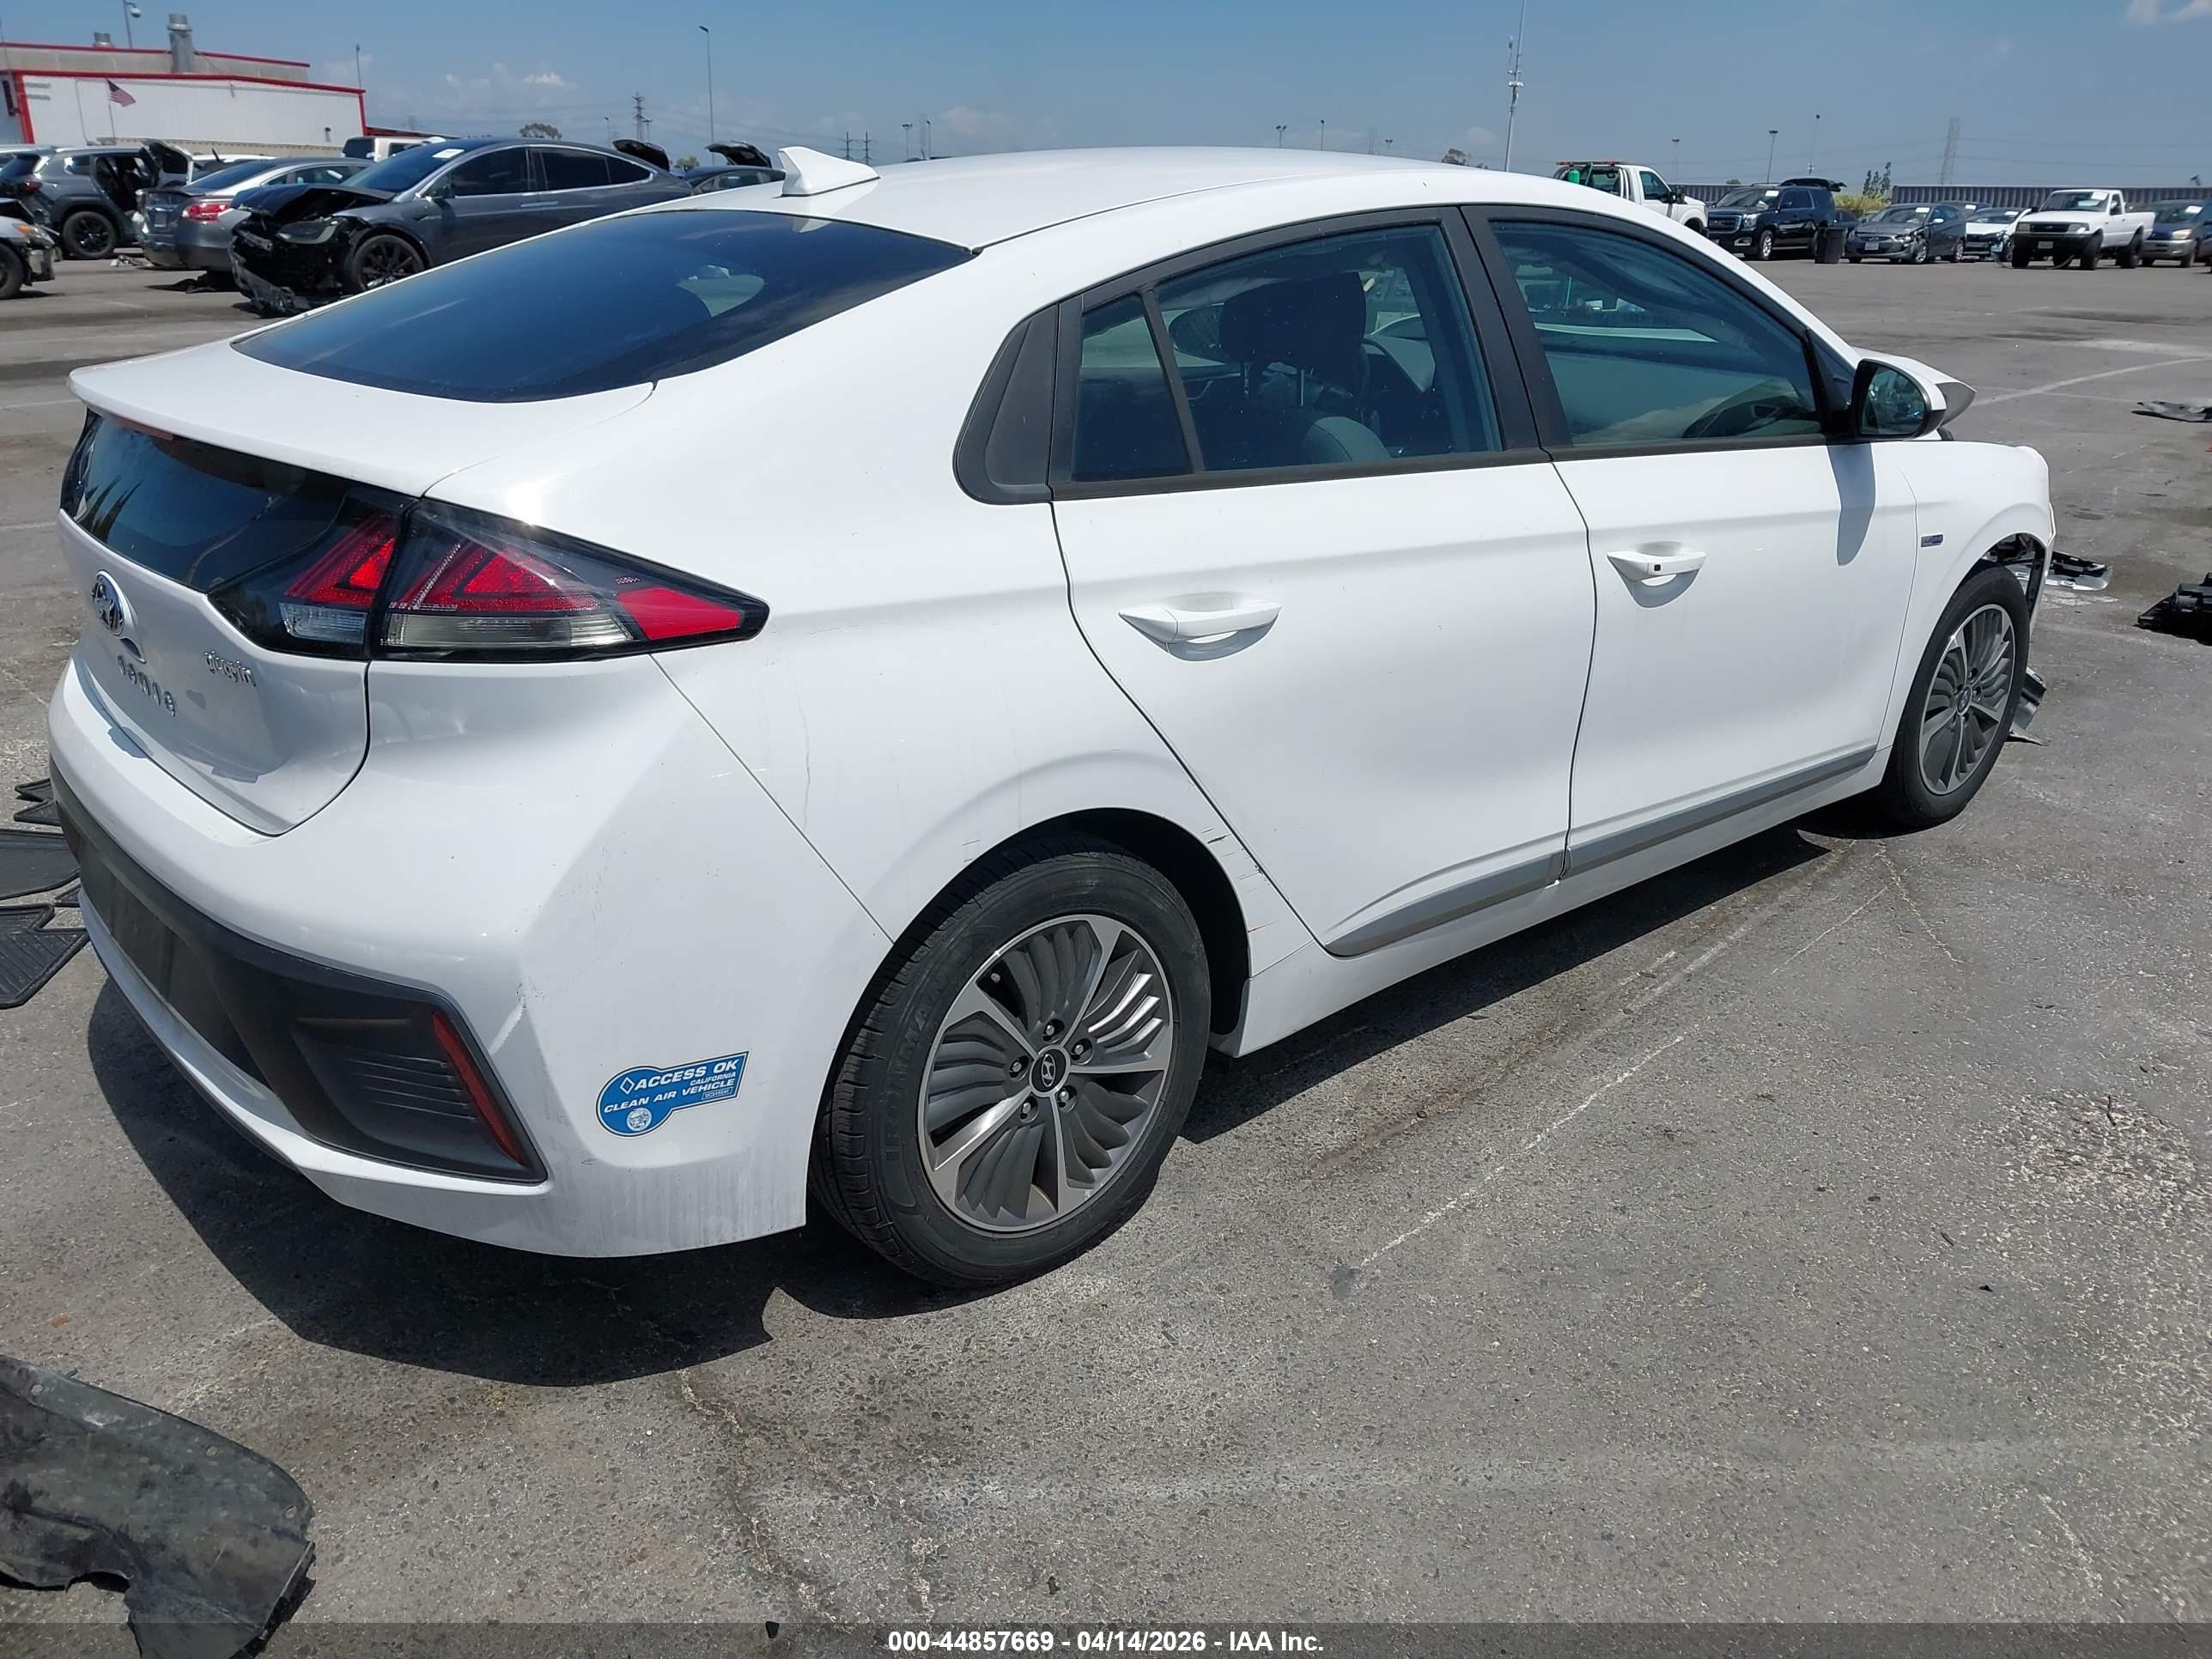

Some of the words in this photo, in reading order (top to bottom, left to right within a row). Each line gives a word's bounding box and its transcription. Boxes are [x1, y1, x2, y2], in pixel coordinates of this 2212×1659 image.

[635, 1066, 707, 1091] ACCESS
[713, 1060, 739, 1074] OK
[690, 1072, 736, 1086] CALIFORNIA
[604, 1097, 649, 1113] CLEAN
[653, 1091, 678, 1103] AIR
[682, 1079, 735, 1096] VEHICLE
